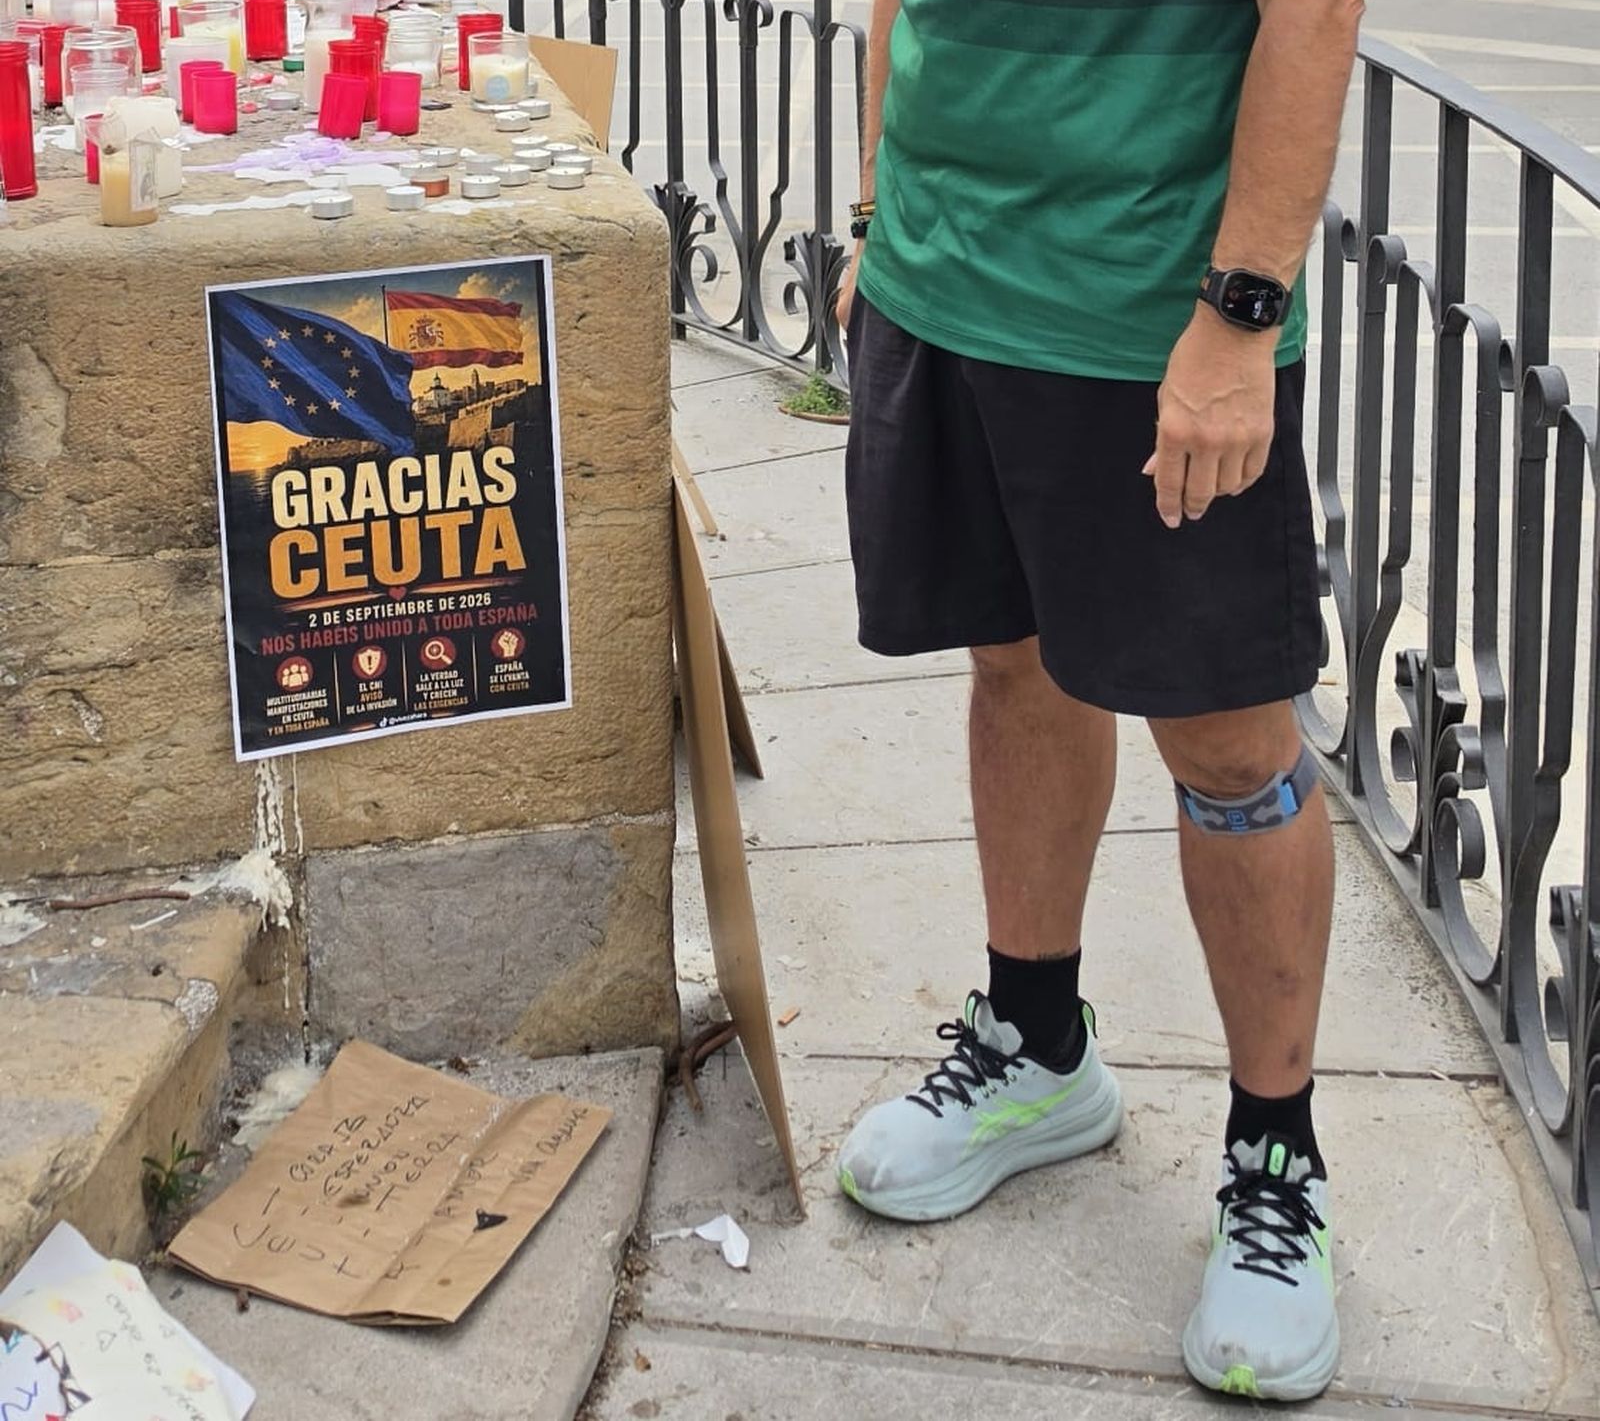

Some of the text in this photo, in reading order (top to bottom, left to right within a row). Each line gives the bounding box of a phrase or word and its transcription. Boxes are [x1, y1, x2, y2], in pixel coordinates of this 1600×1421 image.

[272, 445, 517, 529] GRACIAS
[269, 505, 527, 600] CEUTA
[308, 592, 492, 628] 2 DE SEPTIEMBRE DE 2026
[261, 634, 296, 656] NOS
[364, 618, 413, 640] UNIDO
[418, 618, 428, 634] A
[433, 612, 474, 632] TODA
[478, 601, 538, 626] ESPAÑA
[495, 660, 524, 674] ESPAÑA
[420, 670, 459, 682] LA VERDAD
[359, 682, 368, 692] EL
[415, 678, 465, 692] SALE A LA LUZ
[422, 692, 428, 701] Y
[346, 706, 356, 715] DE
[356, 704, 366, 713] LA
[282, 710, 315, 724] EN CEUTA
[303, 716, 330, 730] ESPAÑA
